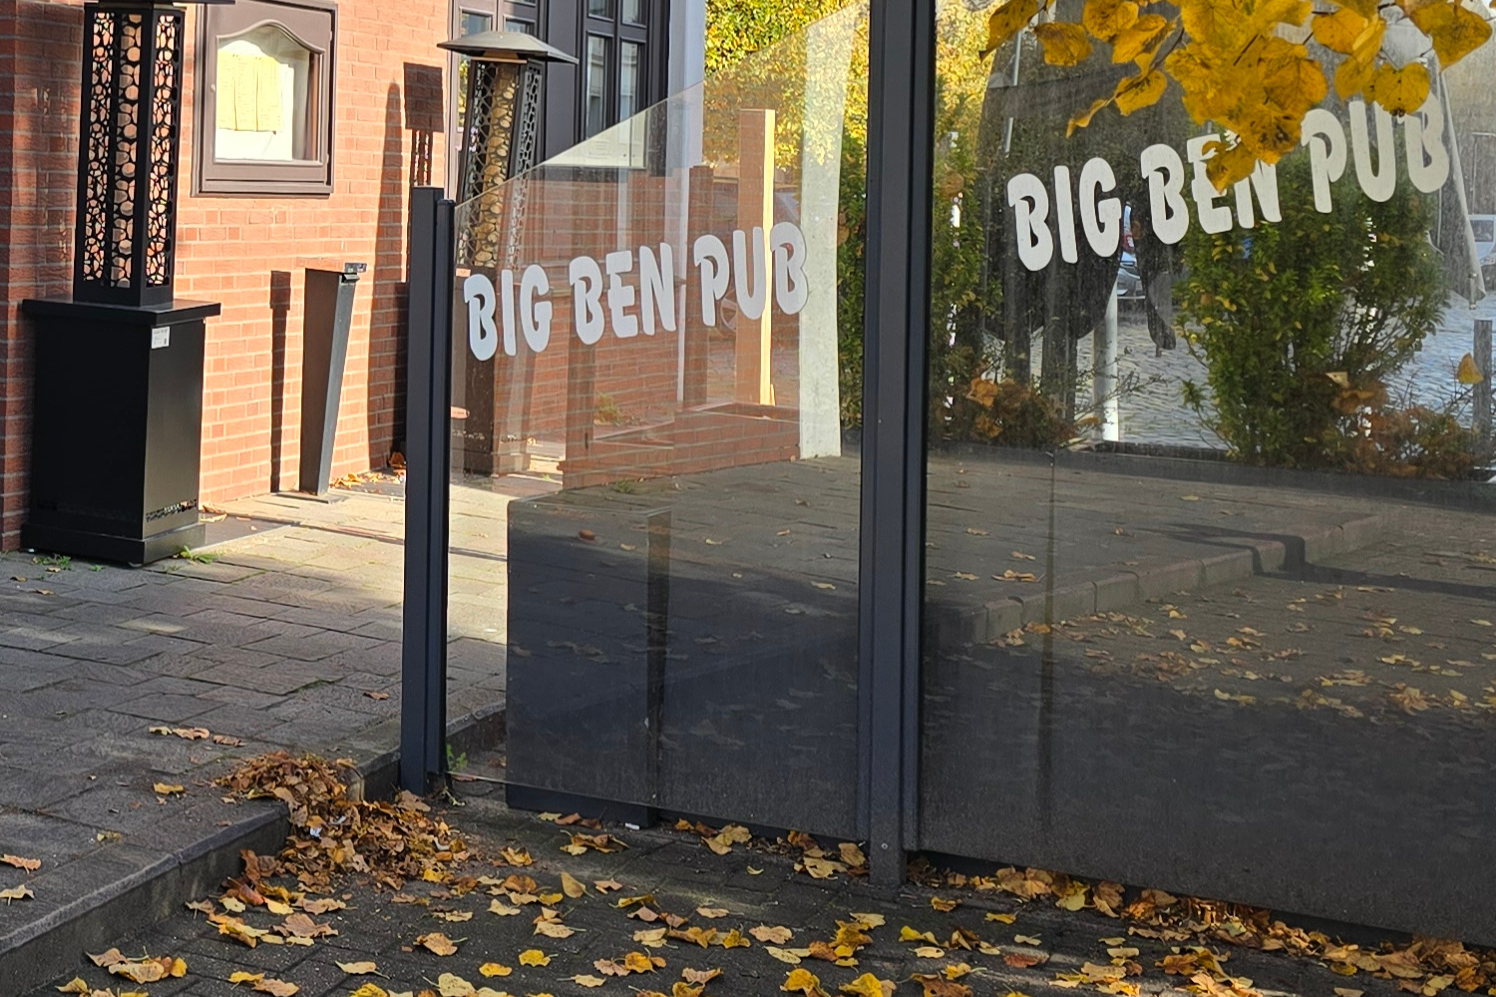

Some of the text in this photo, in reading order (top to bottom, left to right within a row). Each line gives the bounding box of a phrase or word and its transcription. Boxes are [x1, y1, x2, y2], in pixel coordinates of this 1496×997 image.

[1007, 157, 1121, 272] BIG
[1301, 91, 1450, 213] PUB
[464, 221, 809, 362] BIG BEN PUB
